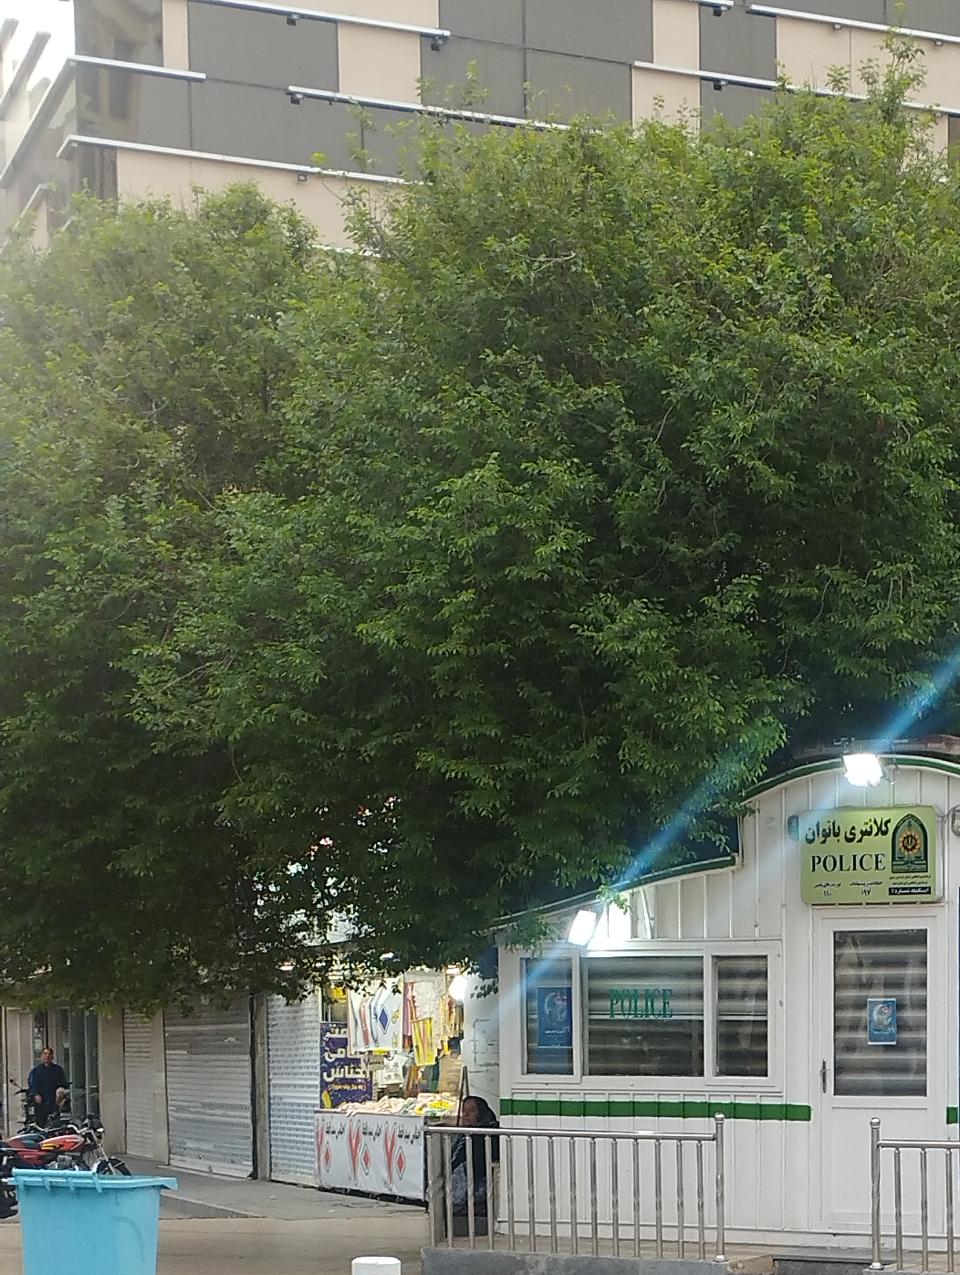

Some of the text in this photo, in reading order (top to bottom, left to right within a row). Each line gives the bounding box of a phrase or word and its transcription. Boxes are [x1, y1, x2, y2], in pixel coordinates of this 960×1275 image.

[805, 817, 892, 845] کلانتری بانوان
[810, 853, 886, 873] POLICE
[608, 988, 673, 1019] POLICE
